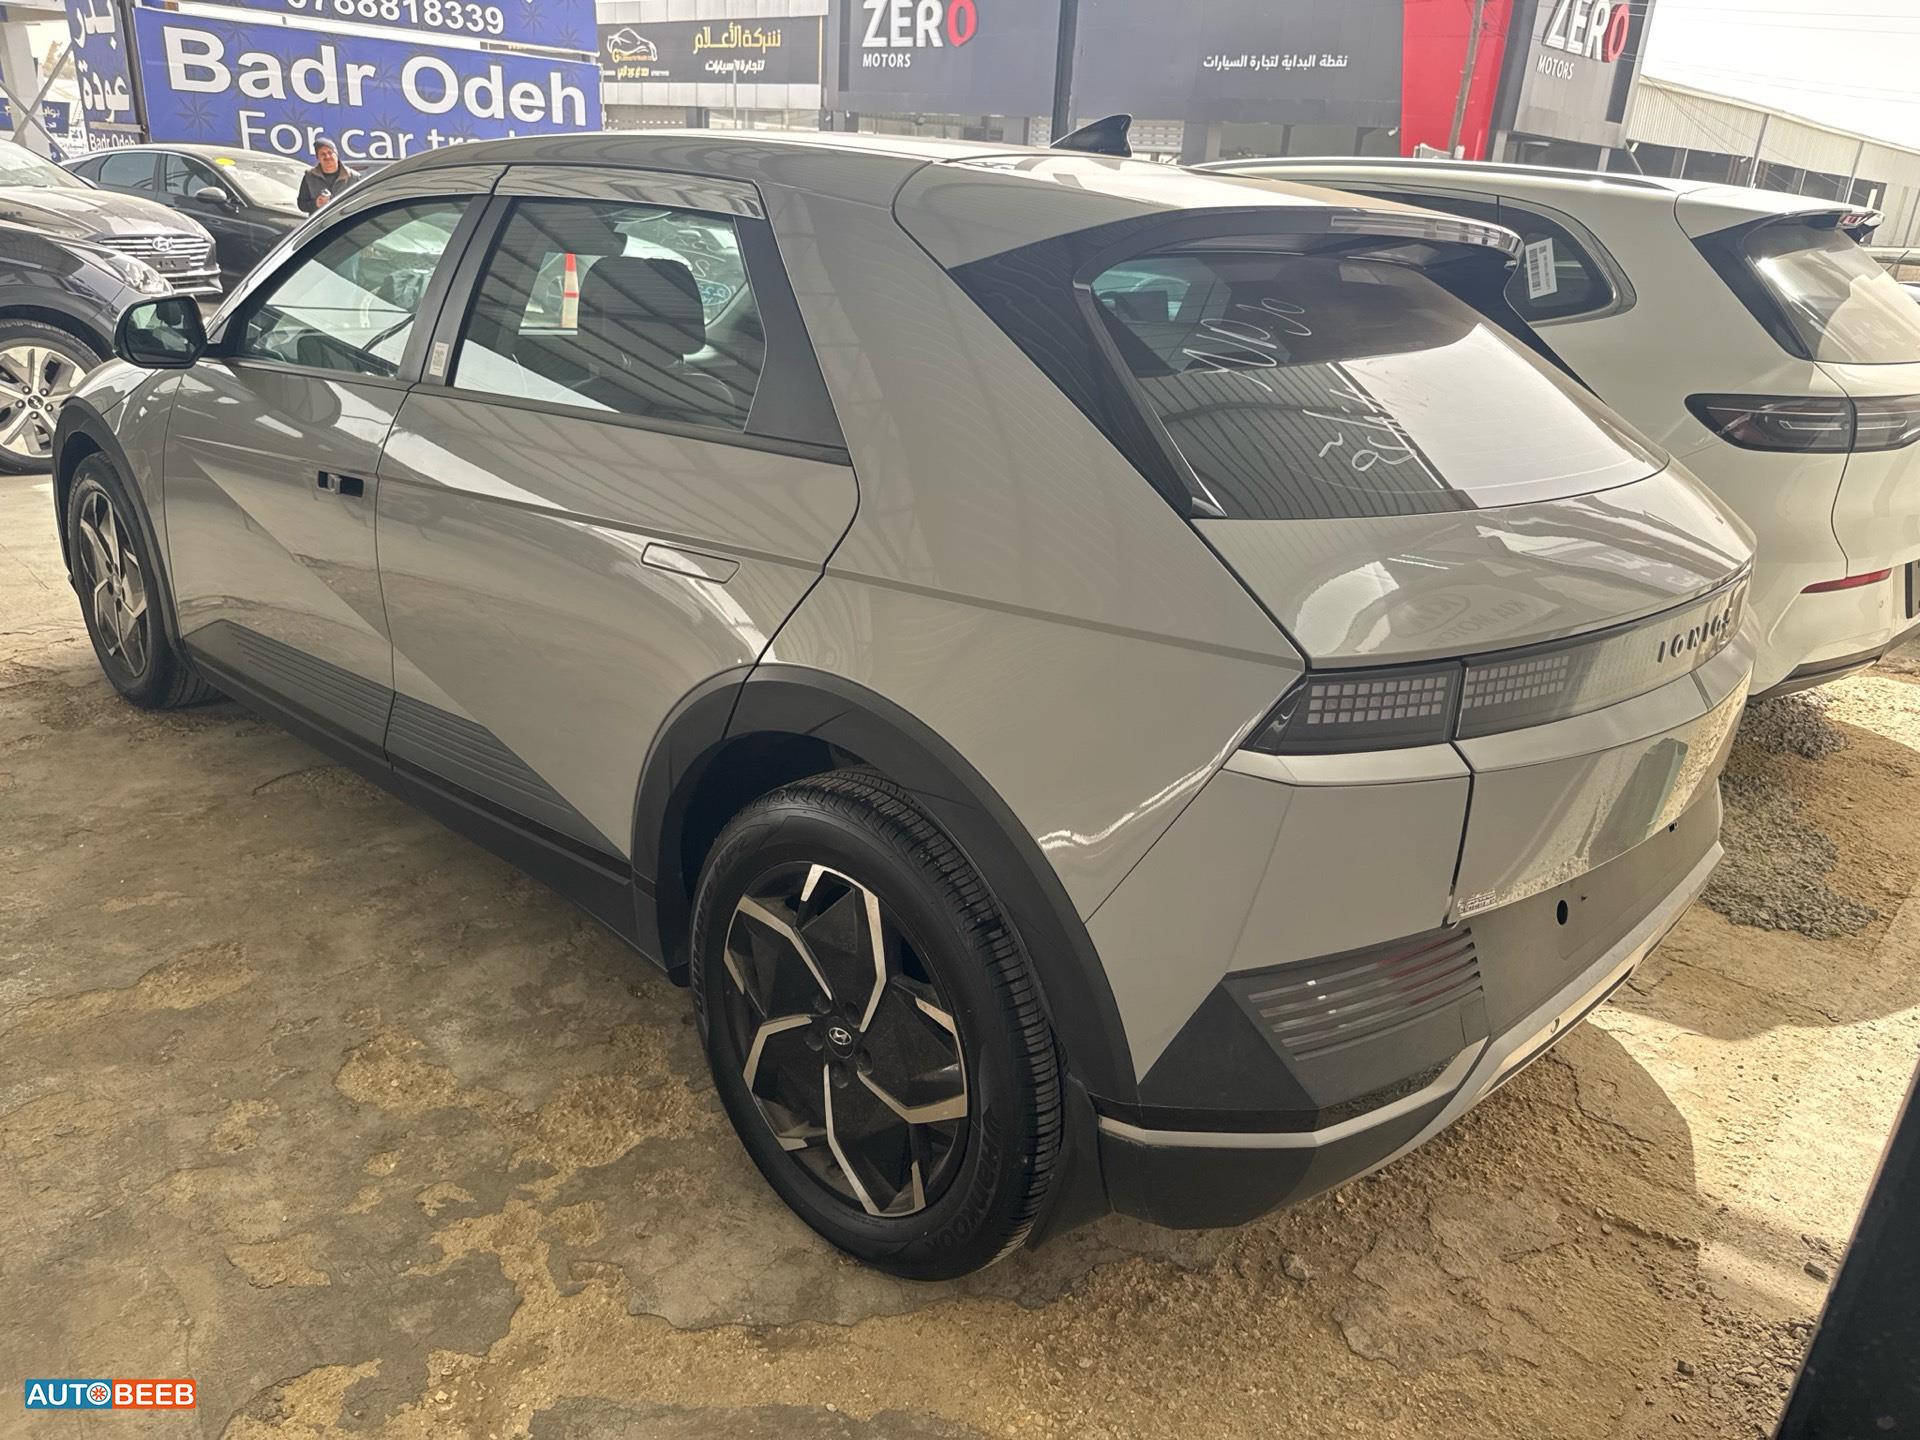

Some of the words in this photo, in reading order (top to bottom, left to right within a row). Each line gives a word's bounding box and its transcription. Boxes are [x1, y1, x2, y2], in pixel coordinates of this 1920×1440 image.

[693, 21, 742, 54] الأعلام
[862, 0, 979, 48] ZERO
[1542, 0, 1630, 63] ZERO
[743, 27, 782, 54] شركة
[862, 53, 912, 68] MOTORS
[1203, 54, 1249, 71] السيارات
[1250, 53, 1280, 71] لتجارة
[1281, 53, 1317, 71] البداية
[1319, 53, 1349, 68] نقطة
[1536, 54, 1575, 80] MOTORS
[163, 26, 376, 106] Badr
[401, 55, 587, 127] Odeh
[78, 59, 130, 122] عودة
[239, 110, 324, 156] For
[341, 129, 414, 160] car
